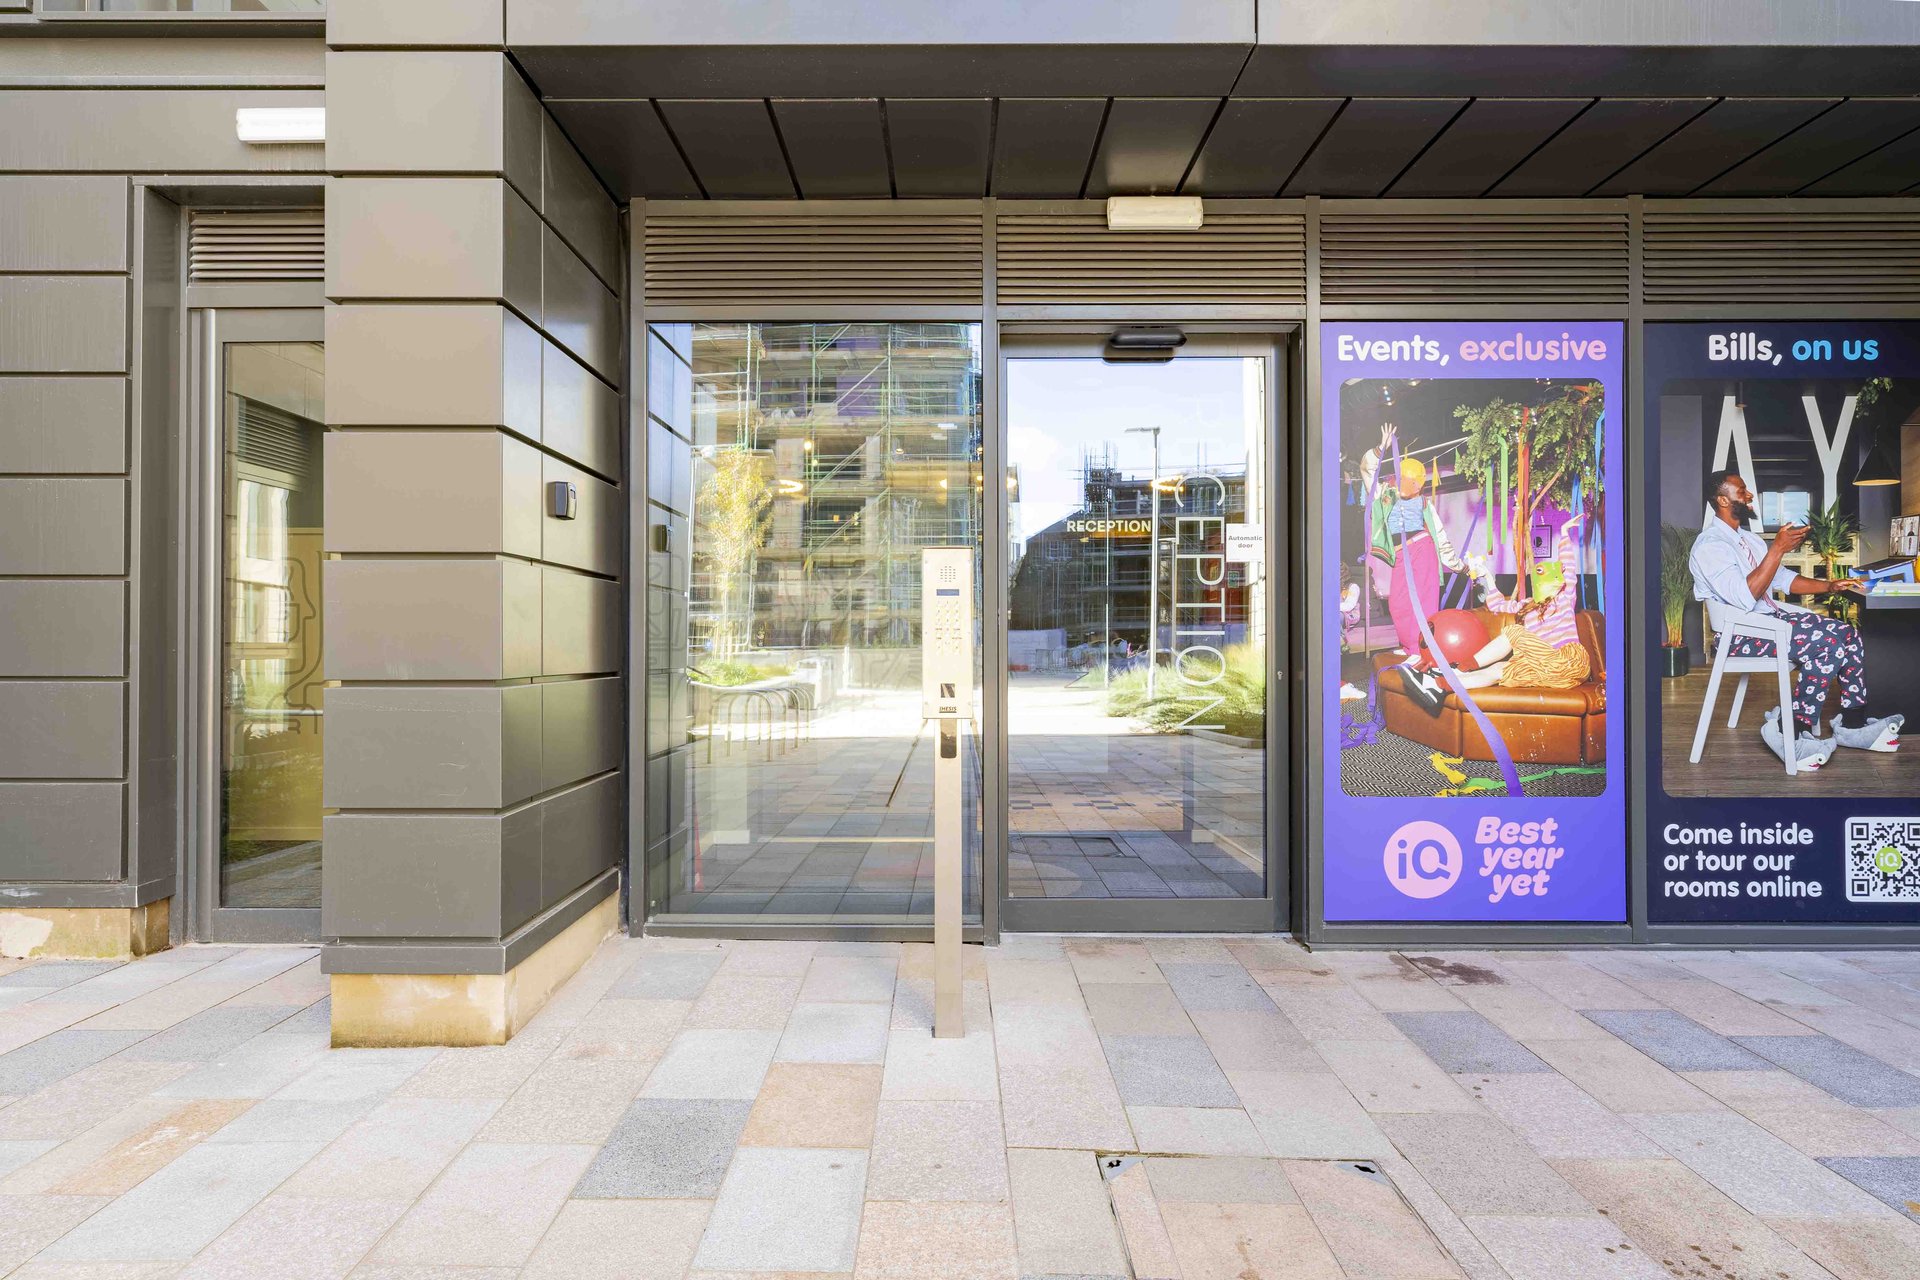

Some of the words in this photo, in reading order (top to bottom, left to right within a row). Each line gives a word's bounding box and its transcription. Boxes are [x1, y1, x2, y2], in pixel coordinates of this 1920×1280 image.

[1337, 334, 1450, 366] Events,
[1459, 332, 1607, 361] exclusive
[1708, 332, 1783, 366] Bills,
[1792, 339, 1832, 361] on
[1843, 339, 1879, 361] us
[1066, 520, 1152, 532] RECEPTION
[1474, 816, 1559, 845] Best
[1663, 823, 1733, 845] Come
[1740, 822, 1814, 845] inside
[1397, 839, 1451, 880] iQ
[1478, 847, 1565, 877] year
[1663, 854, 1689, 872] or
[1695, 850, 1747, 872] tour
[1753, 854, 1796, 872] our
[1488, 869, 1551, 904] yet
[1664, 880, 1740, 898] rooms
[1746, 875, 1823, 898] online
